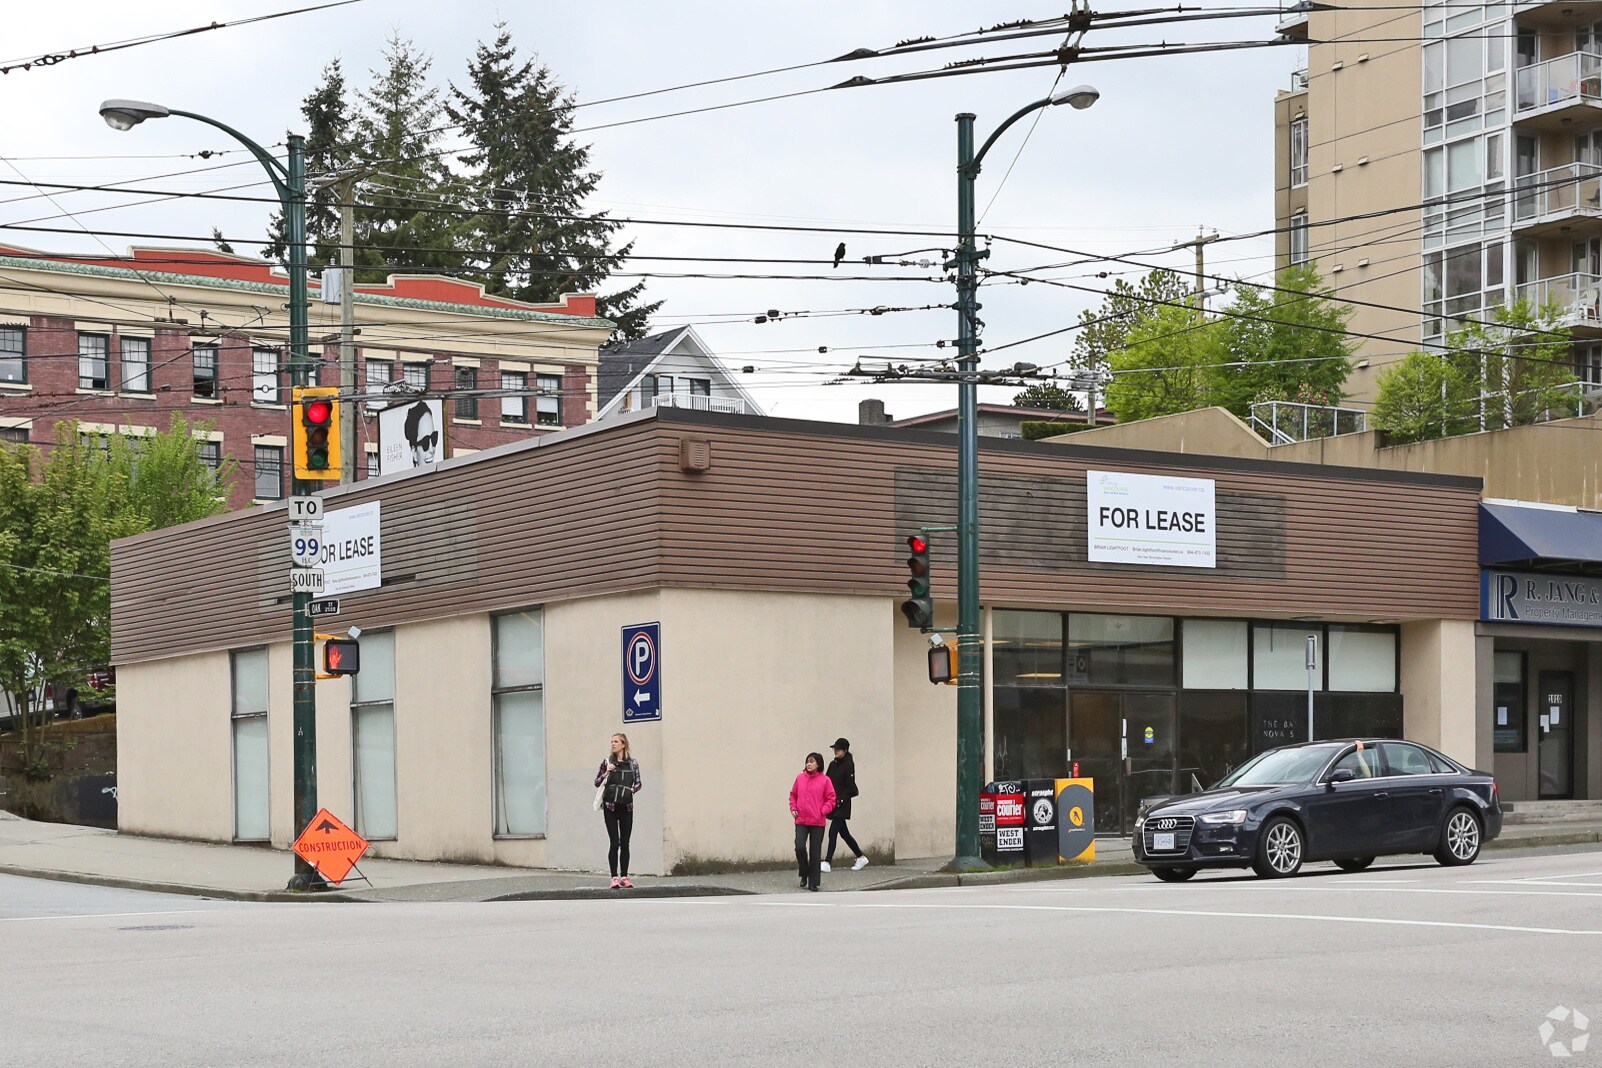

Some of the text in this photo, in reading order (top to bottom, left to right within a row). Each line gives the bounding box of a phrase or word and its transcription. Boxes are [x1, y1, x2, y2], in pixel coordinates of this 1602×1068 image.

[386, 443, 403, 454] EILEEN
[386, 453, 403, 463] FISHER
[294, 501, 317, 515] TO
[1099, 506, 1206, 533] FOR LEASE
[294, 538, 319, 556] 99
[321, 535, 374, 564] OR LEASE
[292, 573, 323, 588] SOUTH
[1525, 579, 1541, 600] R.
[1545, 581, 1586, 604] JANG
[1589, 588, 1599, 604] &
[311, 604, 321, 613] OAK
[1525, 604, 1561, 620] Property
[635, 641, 650, 676] P
[997, 803, 1023, 817] courier
[999, 829, 1020, 838] WEST
[298, 840, 362, 853] CONSTRUCTION
[999, 837, 1022, 847] ENDER
